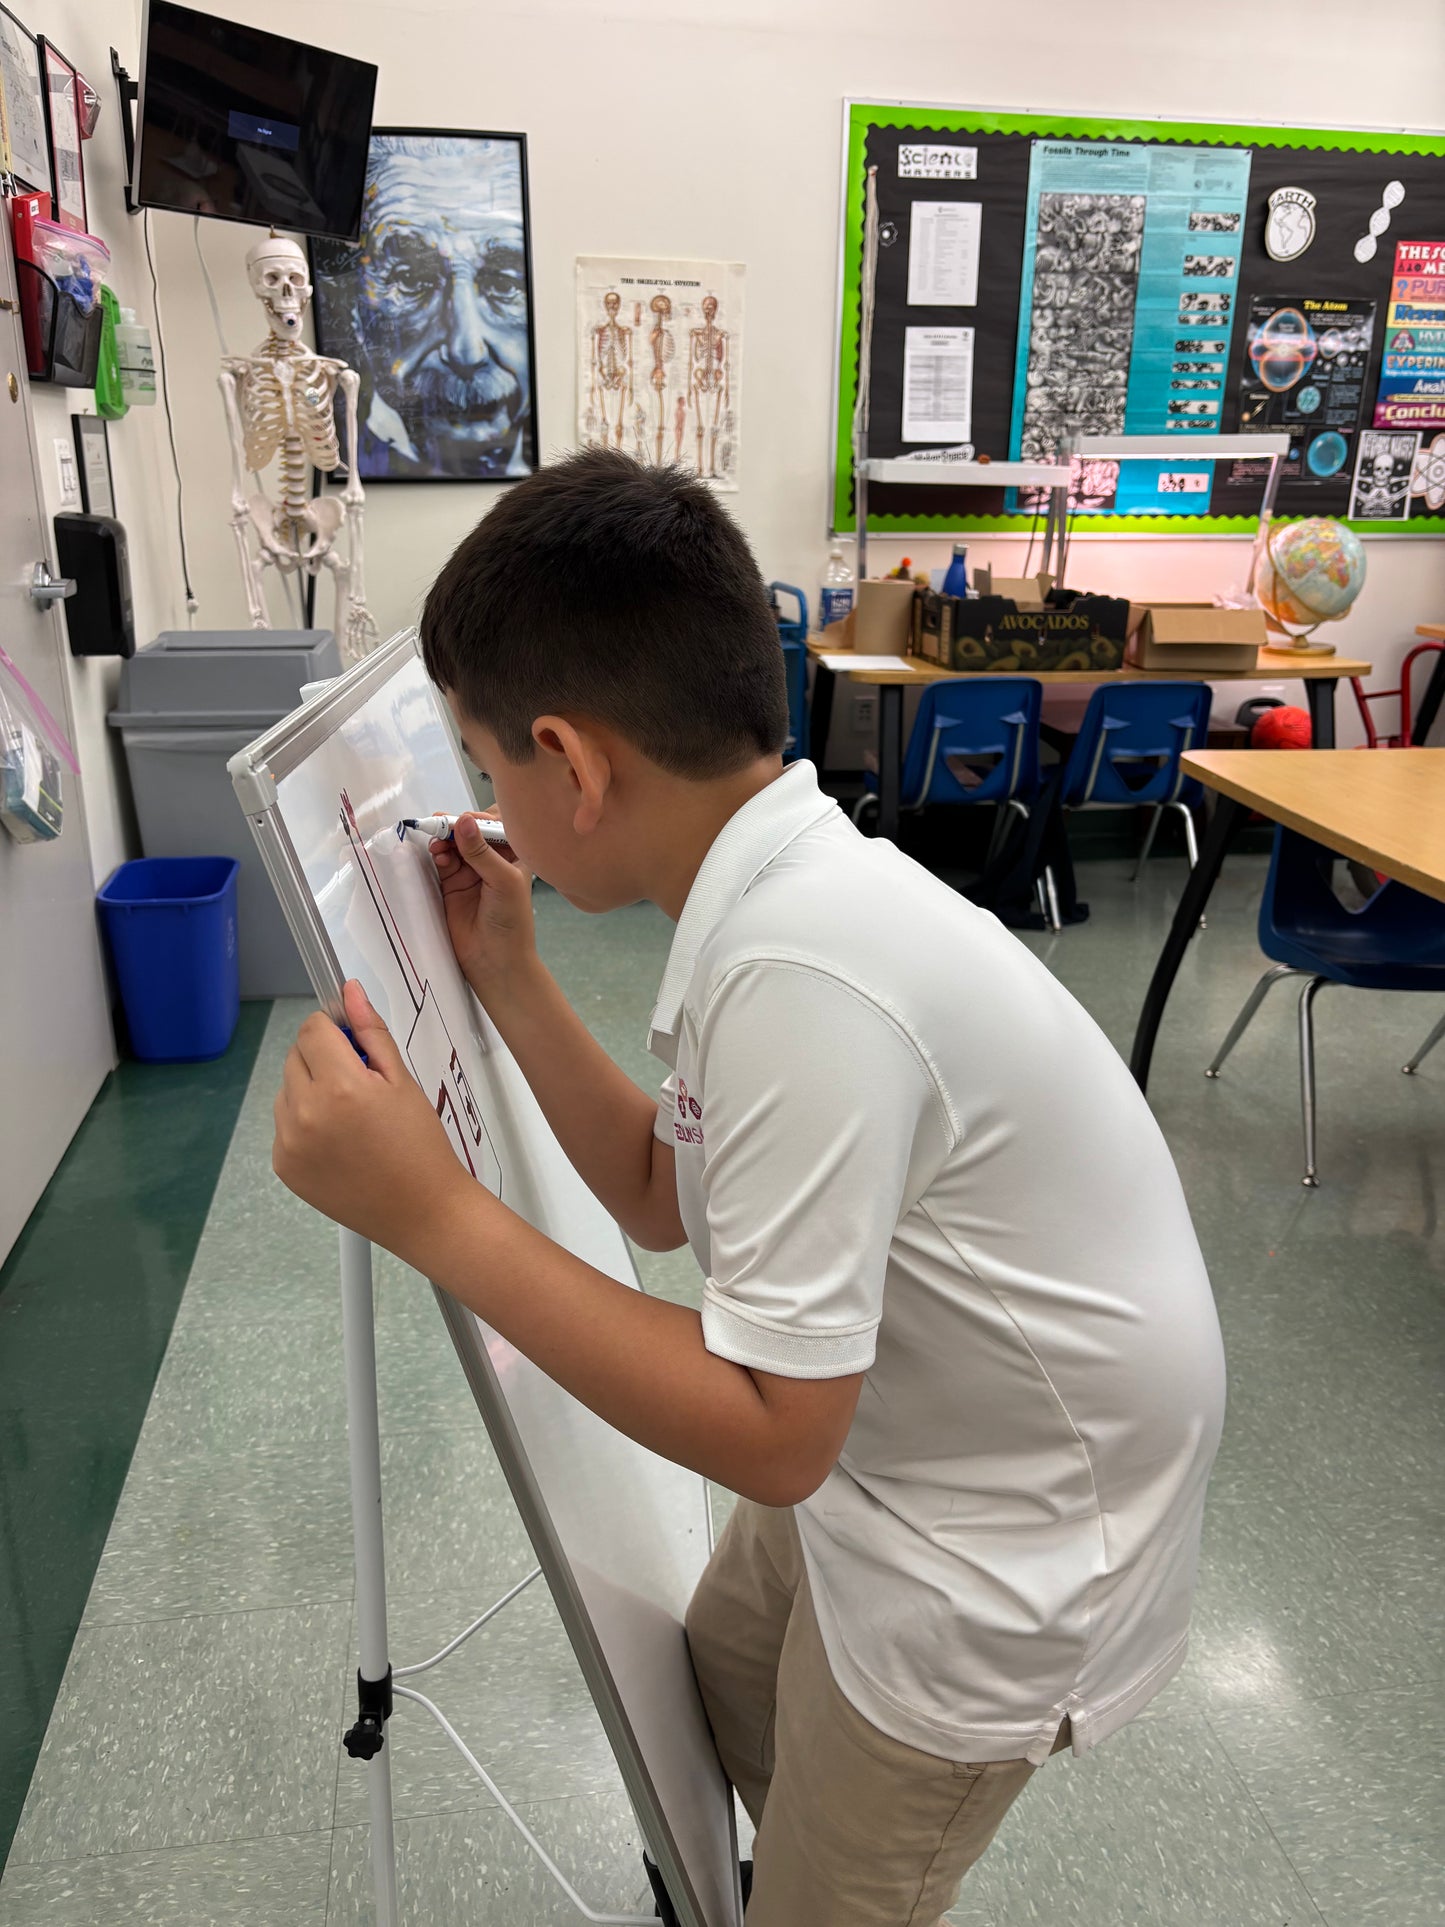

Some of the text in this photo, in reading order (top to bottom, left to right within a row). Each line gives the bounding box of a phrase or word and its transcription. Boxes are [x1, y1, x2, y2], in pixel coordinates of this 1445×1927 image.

[1043, 146, 1130, 158] Fossils Through Time
[903, 169, 971, 178] MATTERS
[1271, 191, 1314, 210] EARTH
[1303, 299, 1348, 312] The Atom
[999, 614, 1089, 630] AVOCADOS
